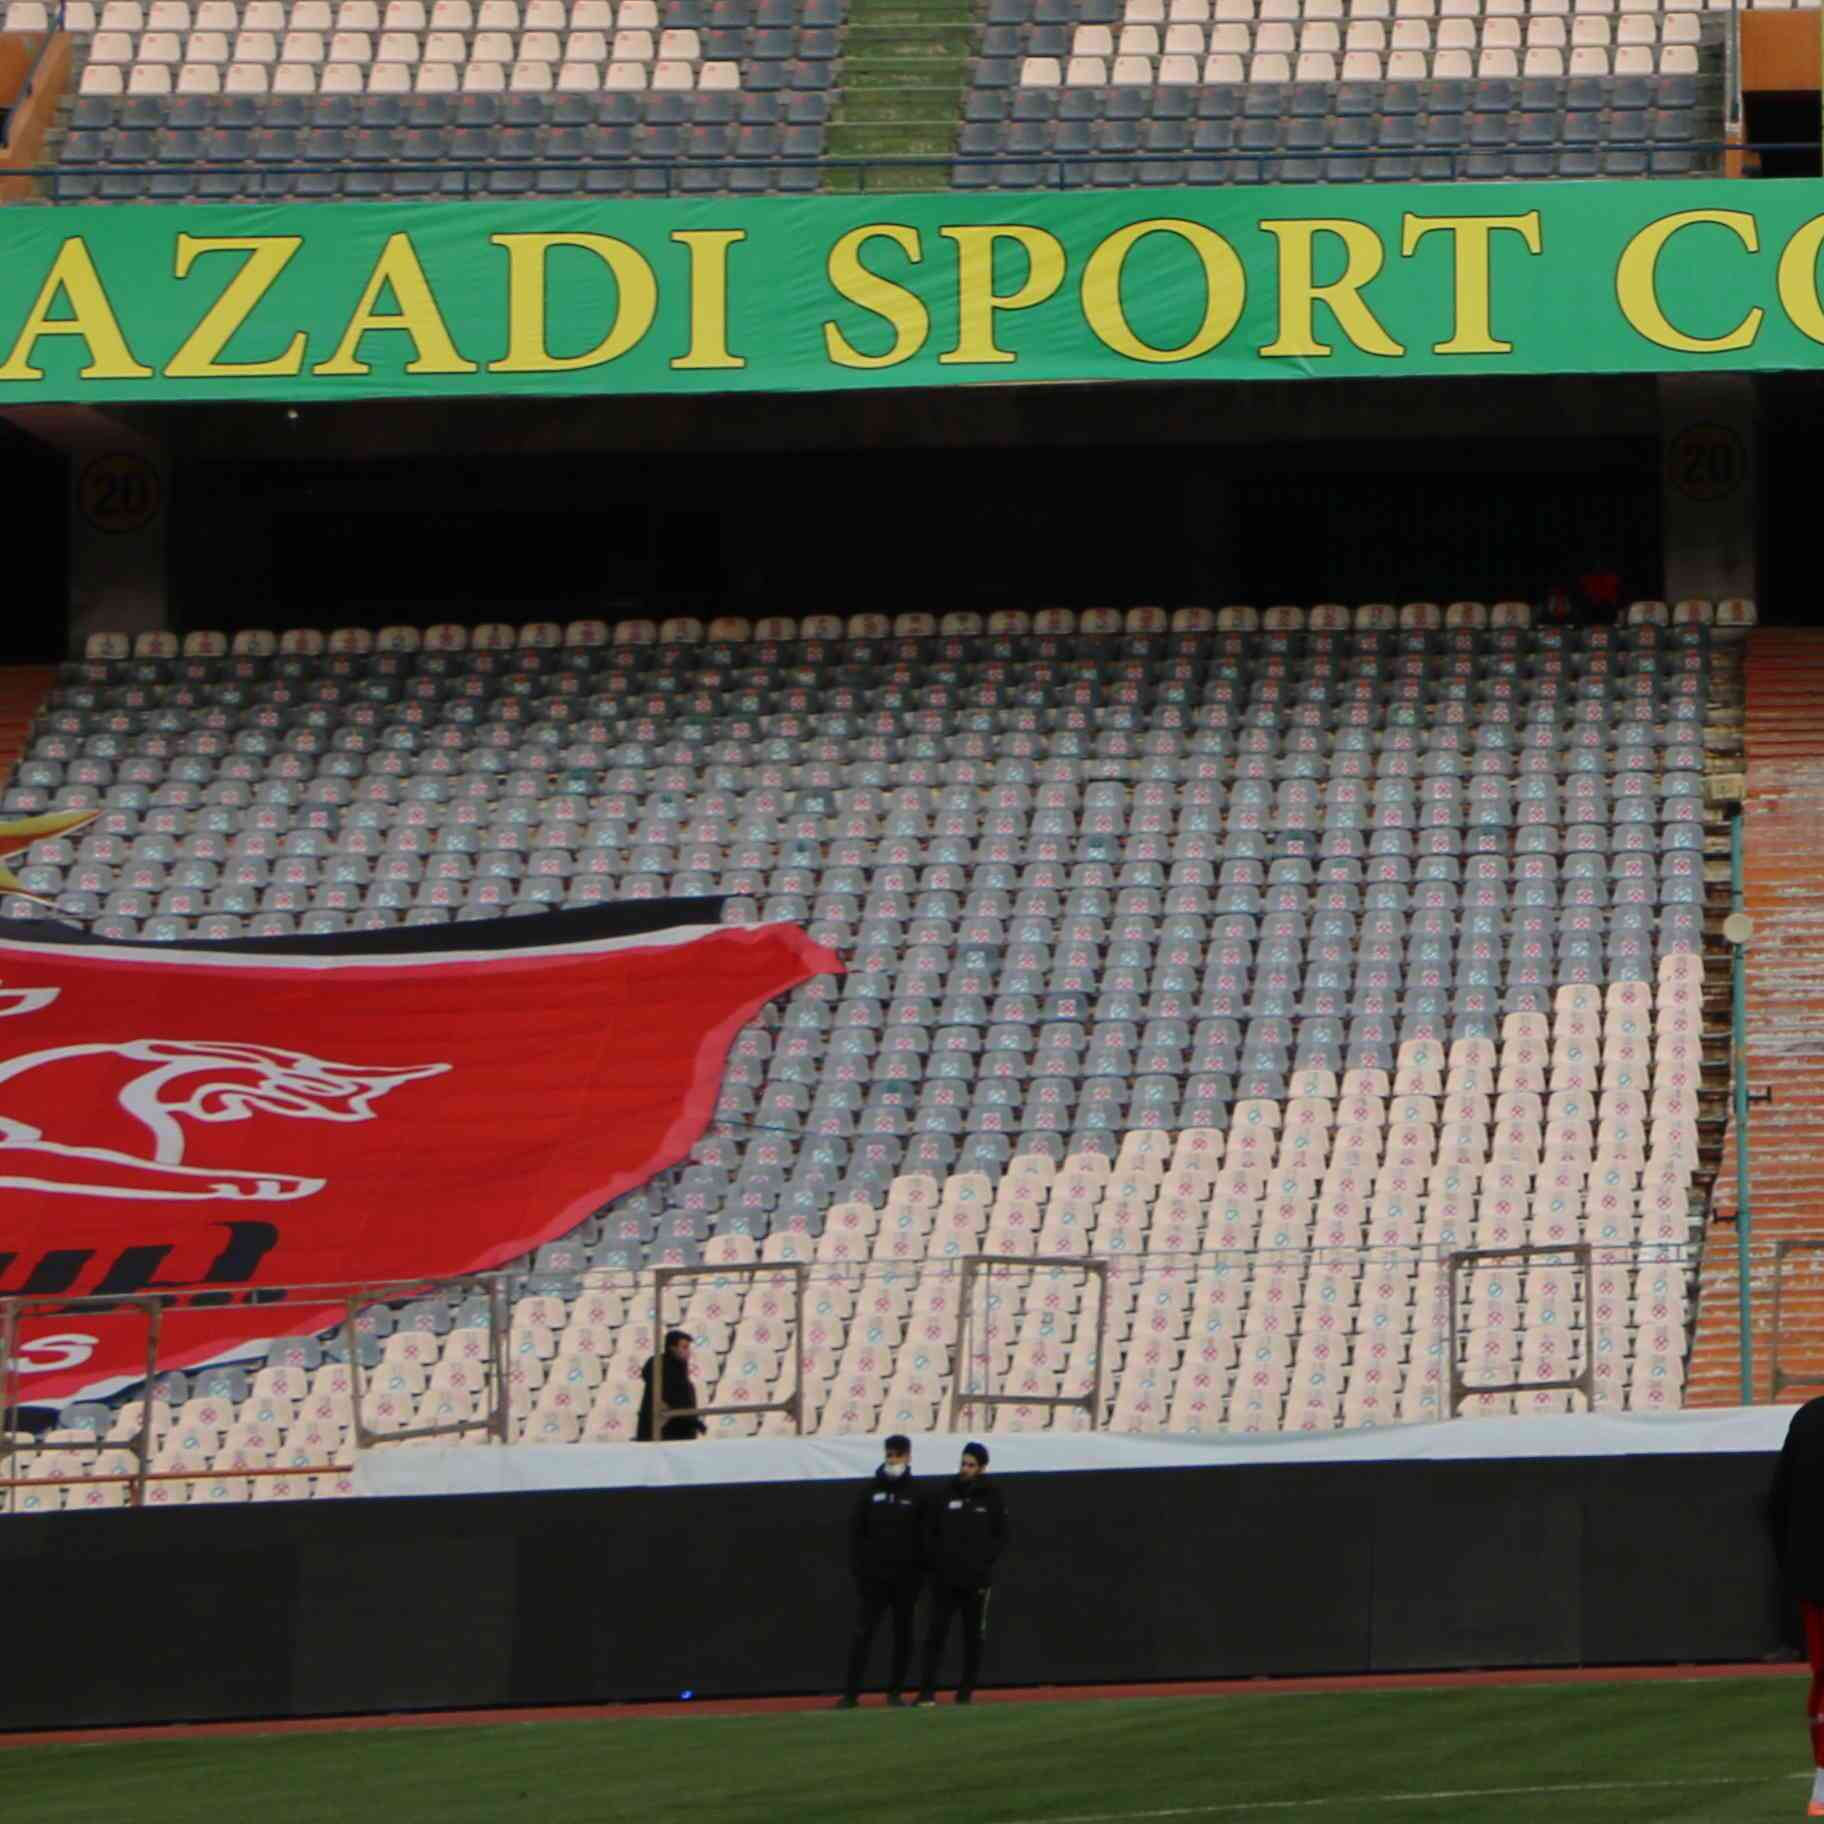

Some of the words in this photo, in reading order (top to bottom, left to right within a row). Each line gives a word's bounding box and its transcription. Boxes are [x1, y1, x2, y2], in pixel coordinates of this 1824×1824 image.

[0, 228, 746, 382] AZADI
[823, 209, 1544, 370] SPORT
[1679, 441, 1738, 485] 20
